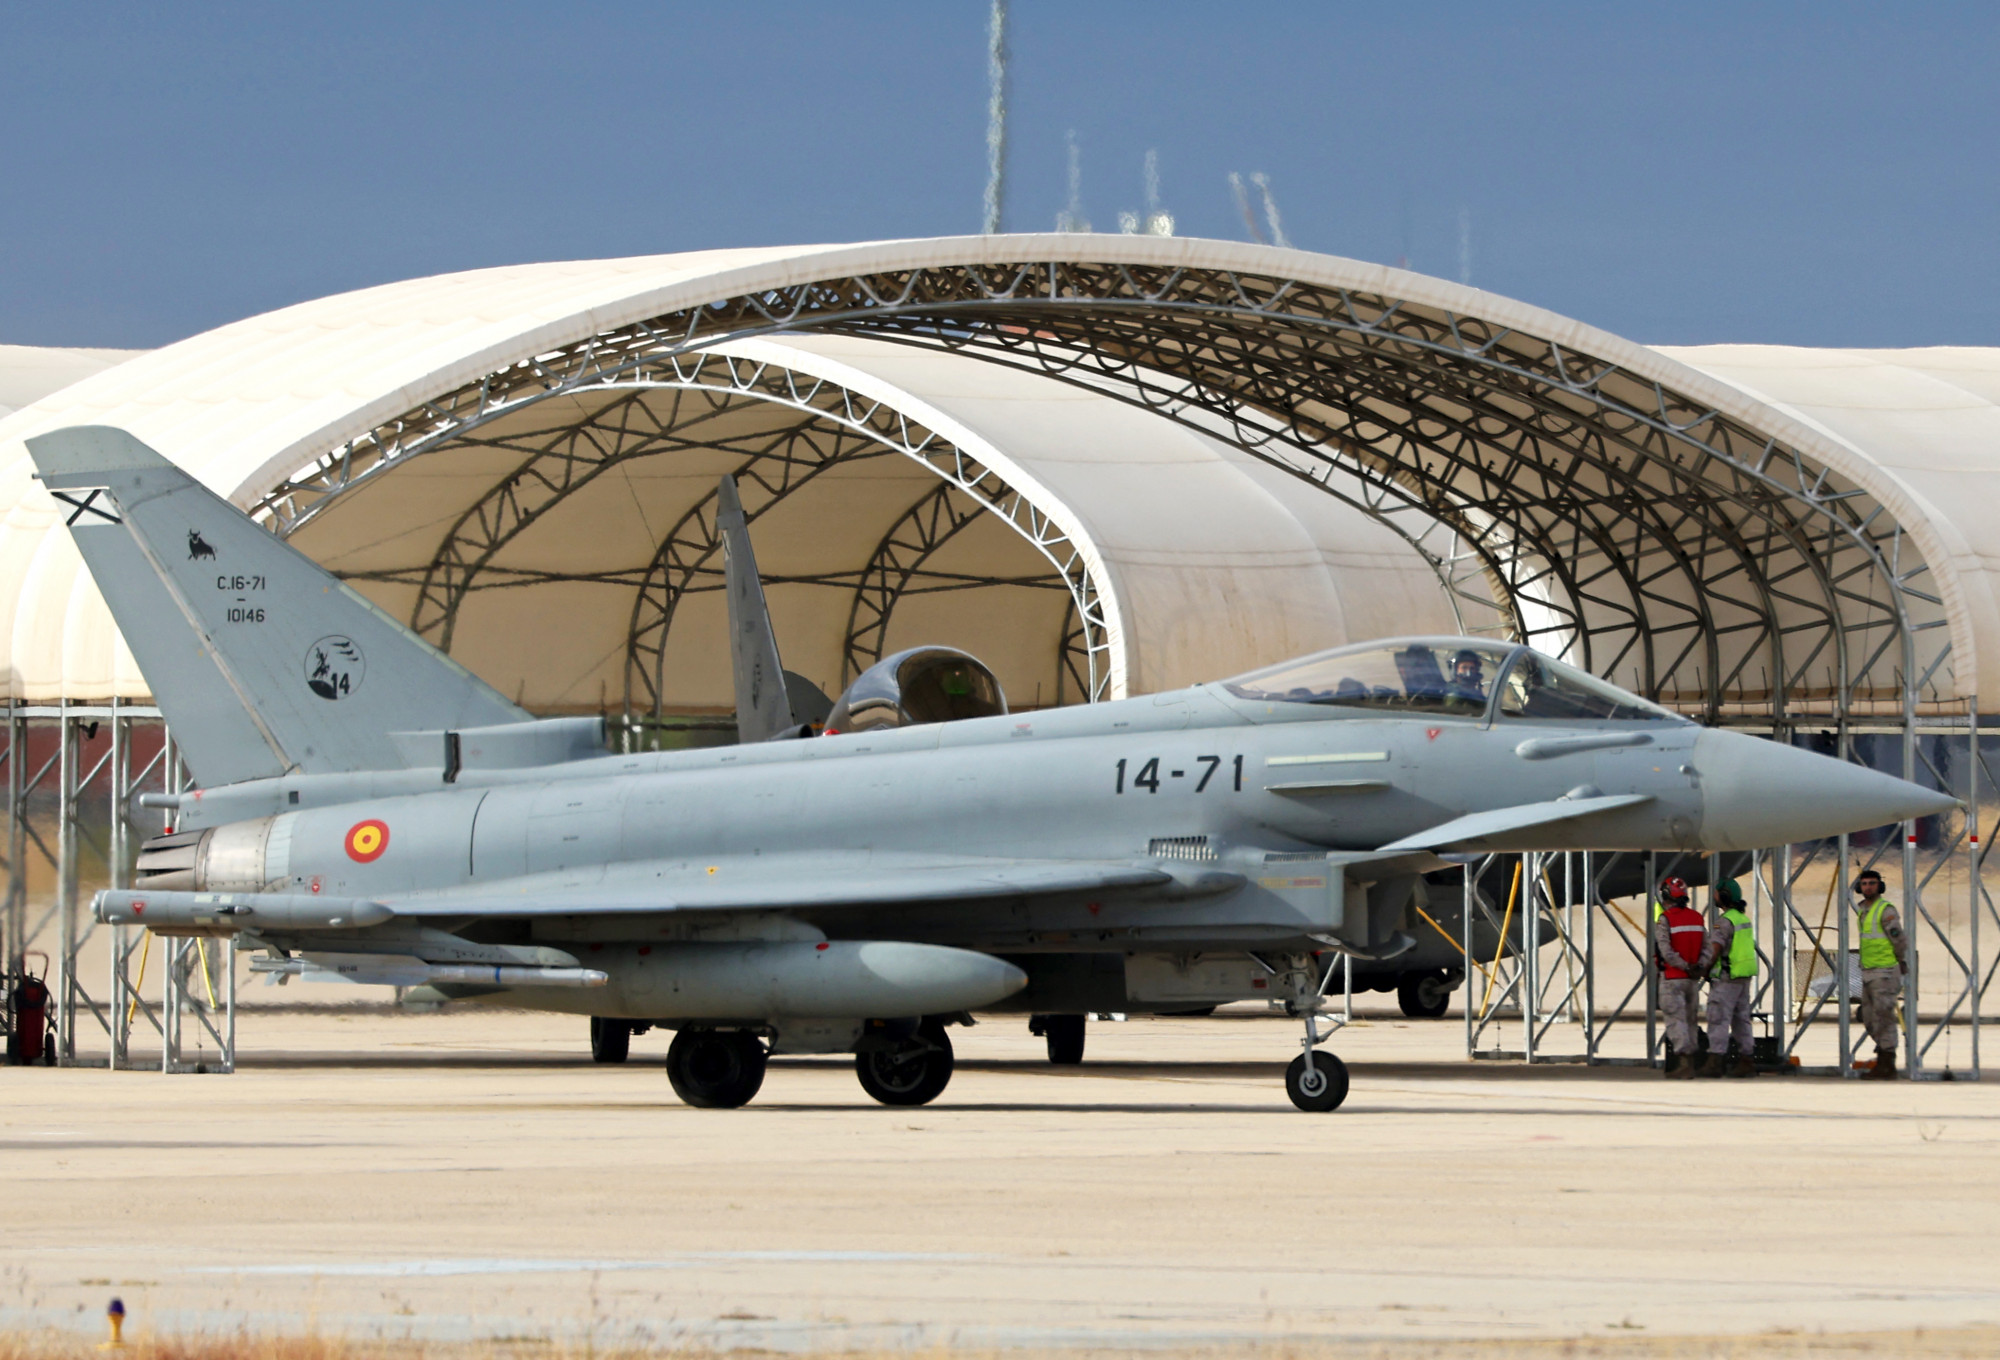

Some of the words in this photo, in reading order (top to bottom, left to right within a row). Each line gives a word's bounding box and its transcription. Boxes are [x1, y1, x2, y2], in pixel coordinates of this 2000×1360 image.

[217, 576, 266, 590] C.16-71
[227, 608, 265, 623] 10146
[331, 672, 351, 696] 14
[1115, 754, 1244, 794] 14-71
